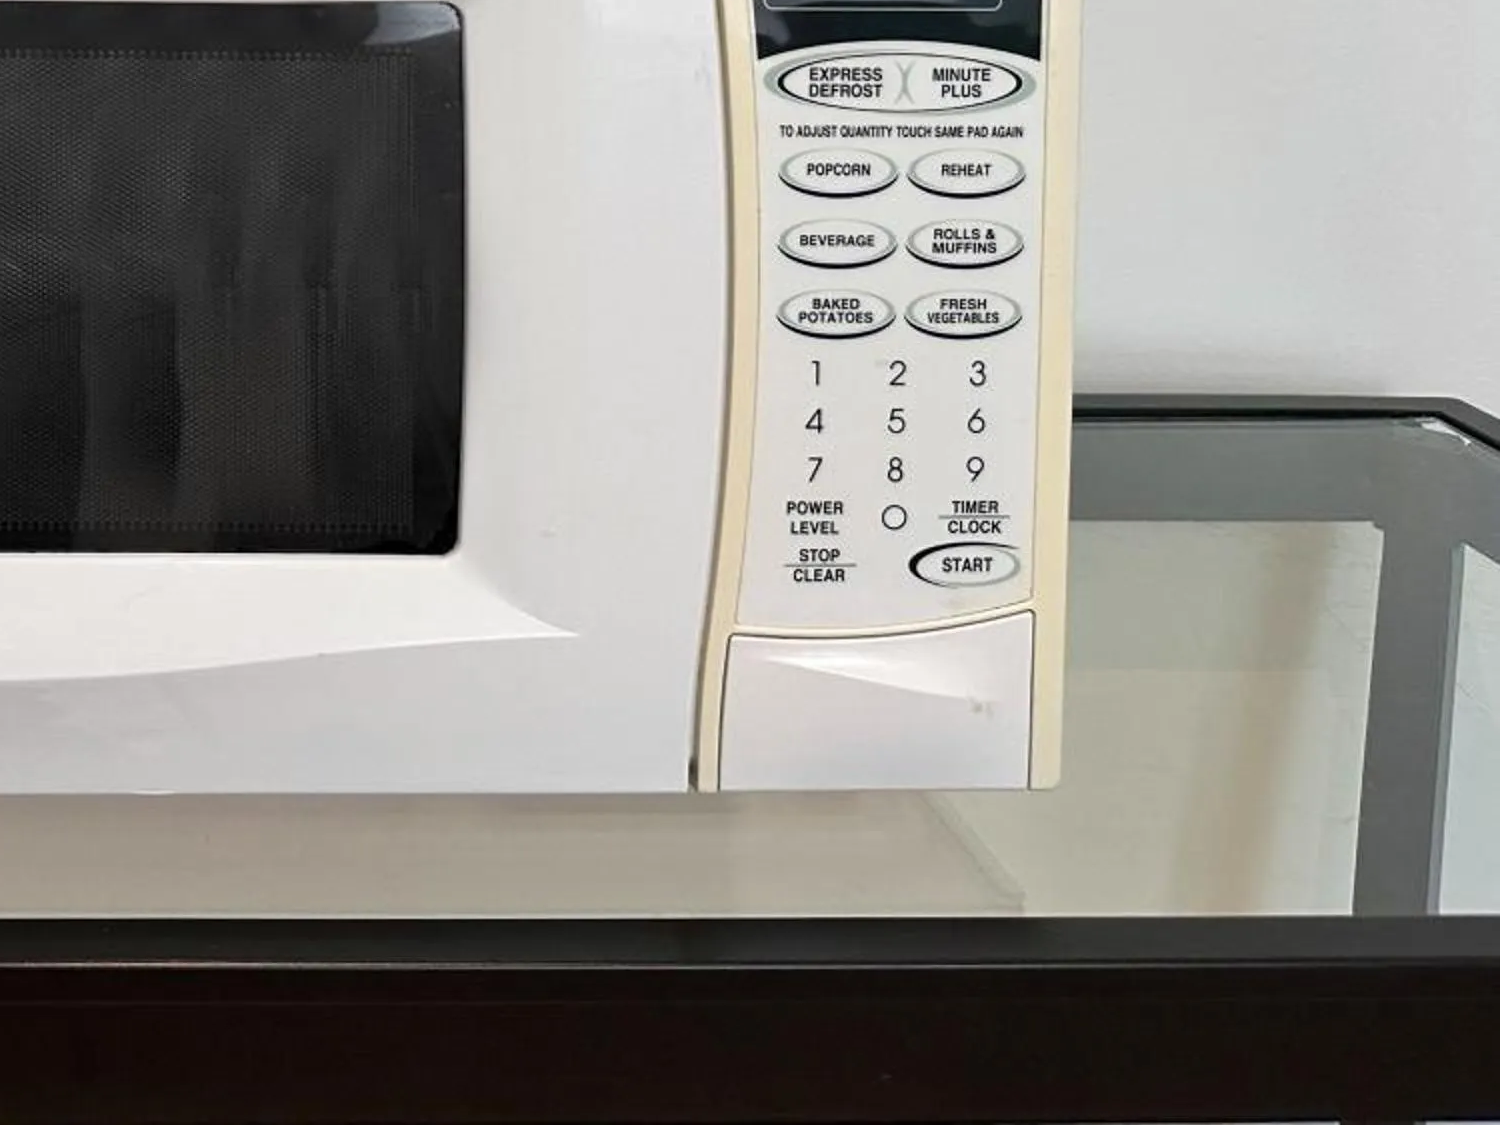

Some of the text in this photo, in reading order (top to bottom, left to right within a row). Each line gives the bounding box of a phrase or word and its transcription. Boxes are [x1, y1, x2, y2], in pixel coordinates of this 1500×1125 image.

[809, 67, 883, 82] EXPRESS
[932, 68, 991, 82] MINUTE
[809, 84, 883, 98] DEFROST
[941, 84, 982, 98] PLUS
[780, 125, 1023, 138] TO ADJUST QUANTITY TOUCH SAME PAD AGAIN
[807, 163, 871, 176] POPCORN
[941, 164, 991, 176] REHEAT
[799, 234, 875, 247] BEVERAGE
[933, 228, 996, 240] ROLLS &
[931, 242, 997, 254] MUFFINS
[812, 298, 860, 310] BAKED
[940, 298, 987, 310] FRESH
[798, 312, 874, 324] POTATOES
[927, 312, 1000, 324] VEGETABLES
[811, 360, 821, 386] 1
[889, 360, 907, 386] 2
[969, 360, 986, 386] 3
[805, 408, 825, 434] 4
[887, 408, 907, 434] 5
[967, 408, 985, 434] 6
[808, 457, 824, 483] 7
[887, 456, 904, 483] 8
[967, 456, 985, 482] 9
[786, 501, 844, 515] POWER
[952, 501, 999, 514] TIMER
[790, 521, 839, 535] LEVEL
[947, 520, 1002, 534] CLOCK
[799, 549, 841, 562] STOP
[941, 558, 993, 572] START
[793, 569, 845, 582] CLEAR
